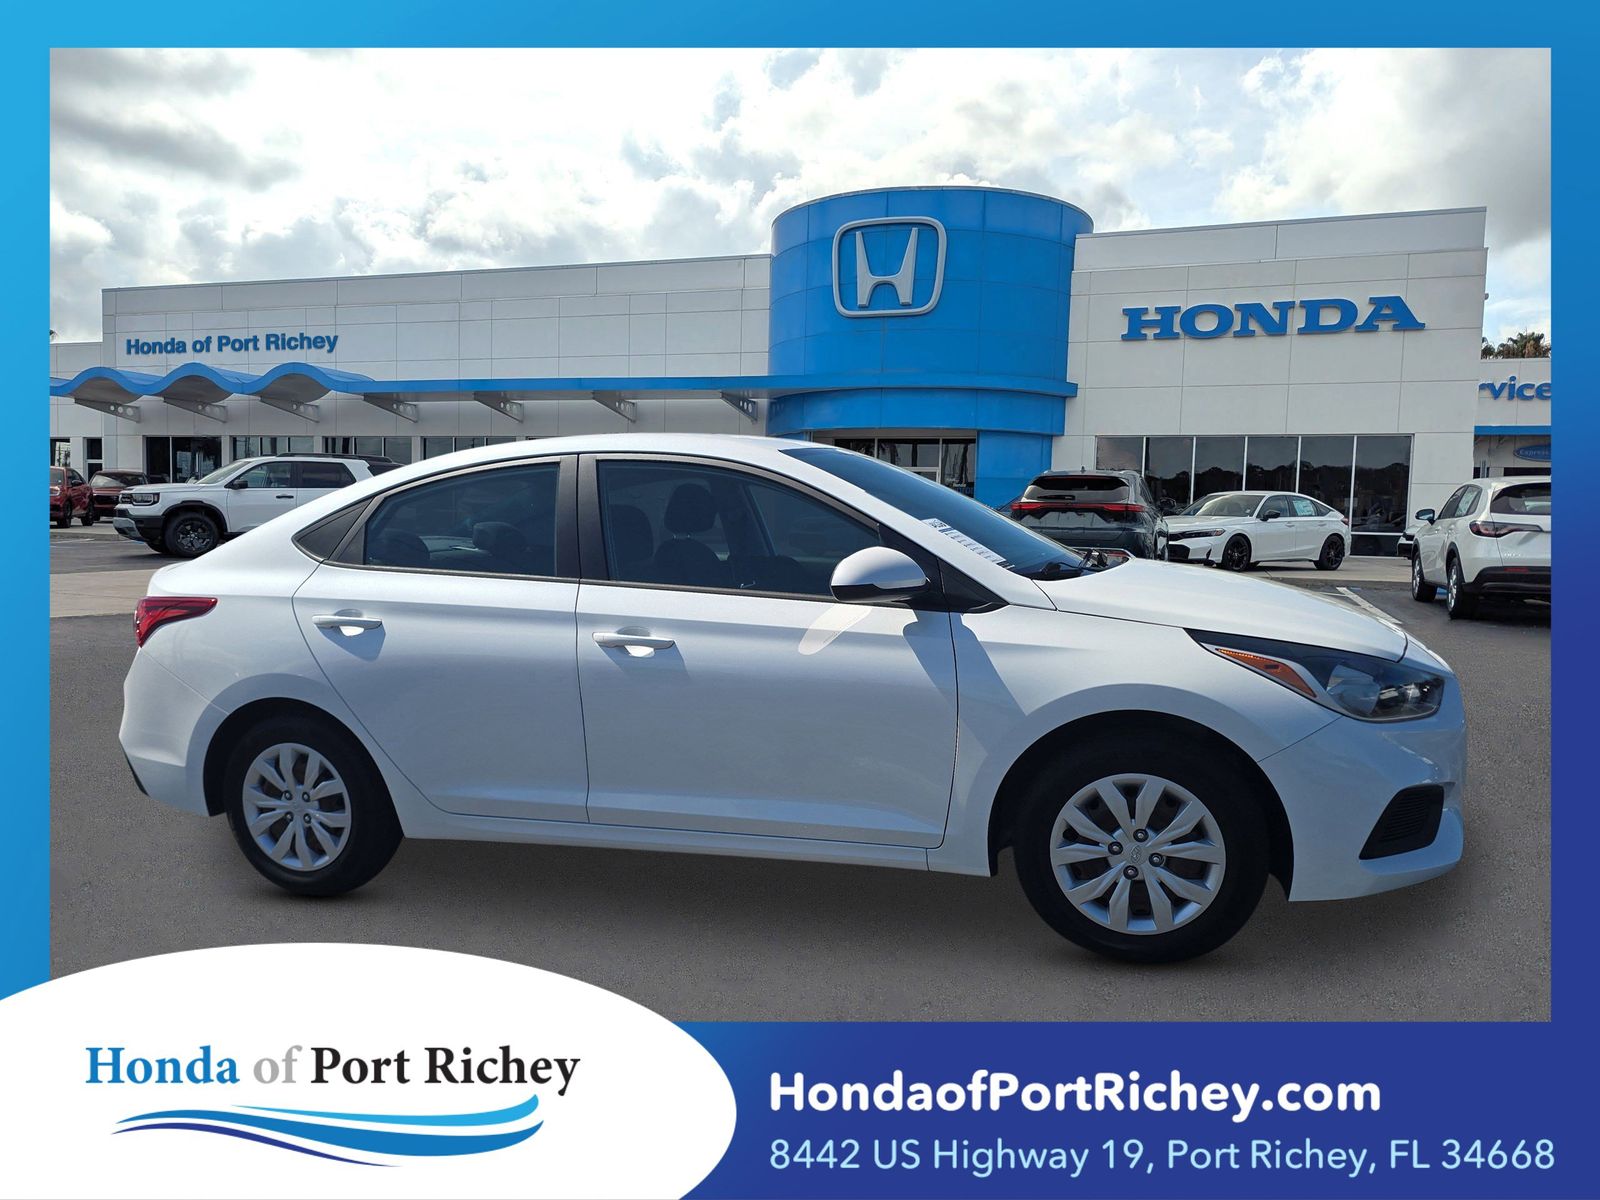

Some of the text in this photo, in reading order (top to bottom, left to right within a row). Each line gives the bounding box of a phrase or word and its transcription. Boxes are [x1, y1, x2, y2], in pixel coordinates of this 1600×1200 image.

[1120, 295, 1425, 341] HONDA
[126, 332, 339, 355] Honda of Port Richey
